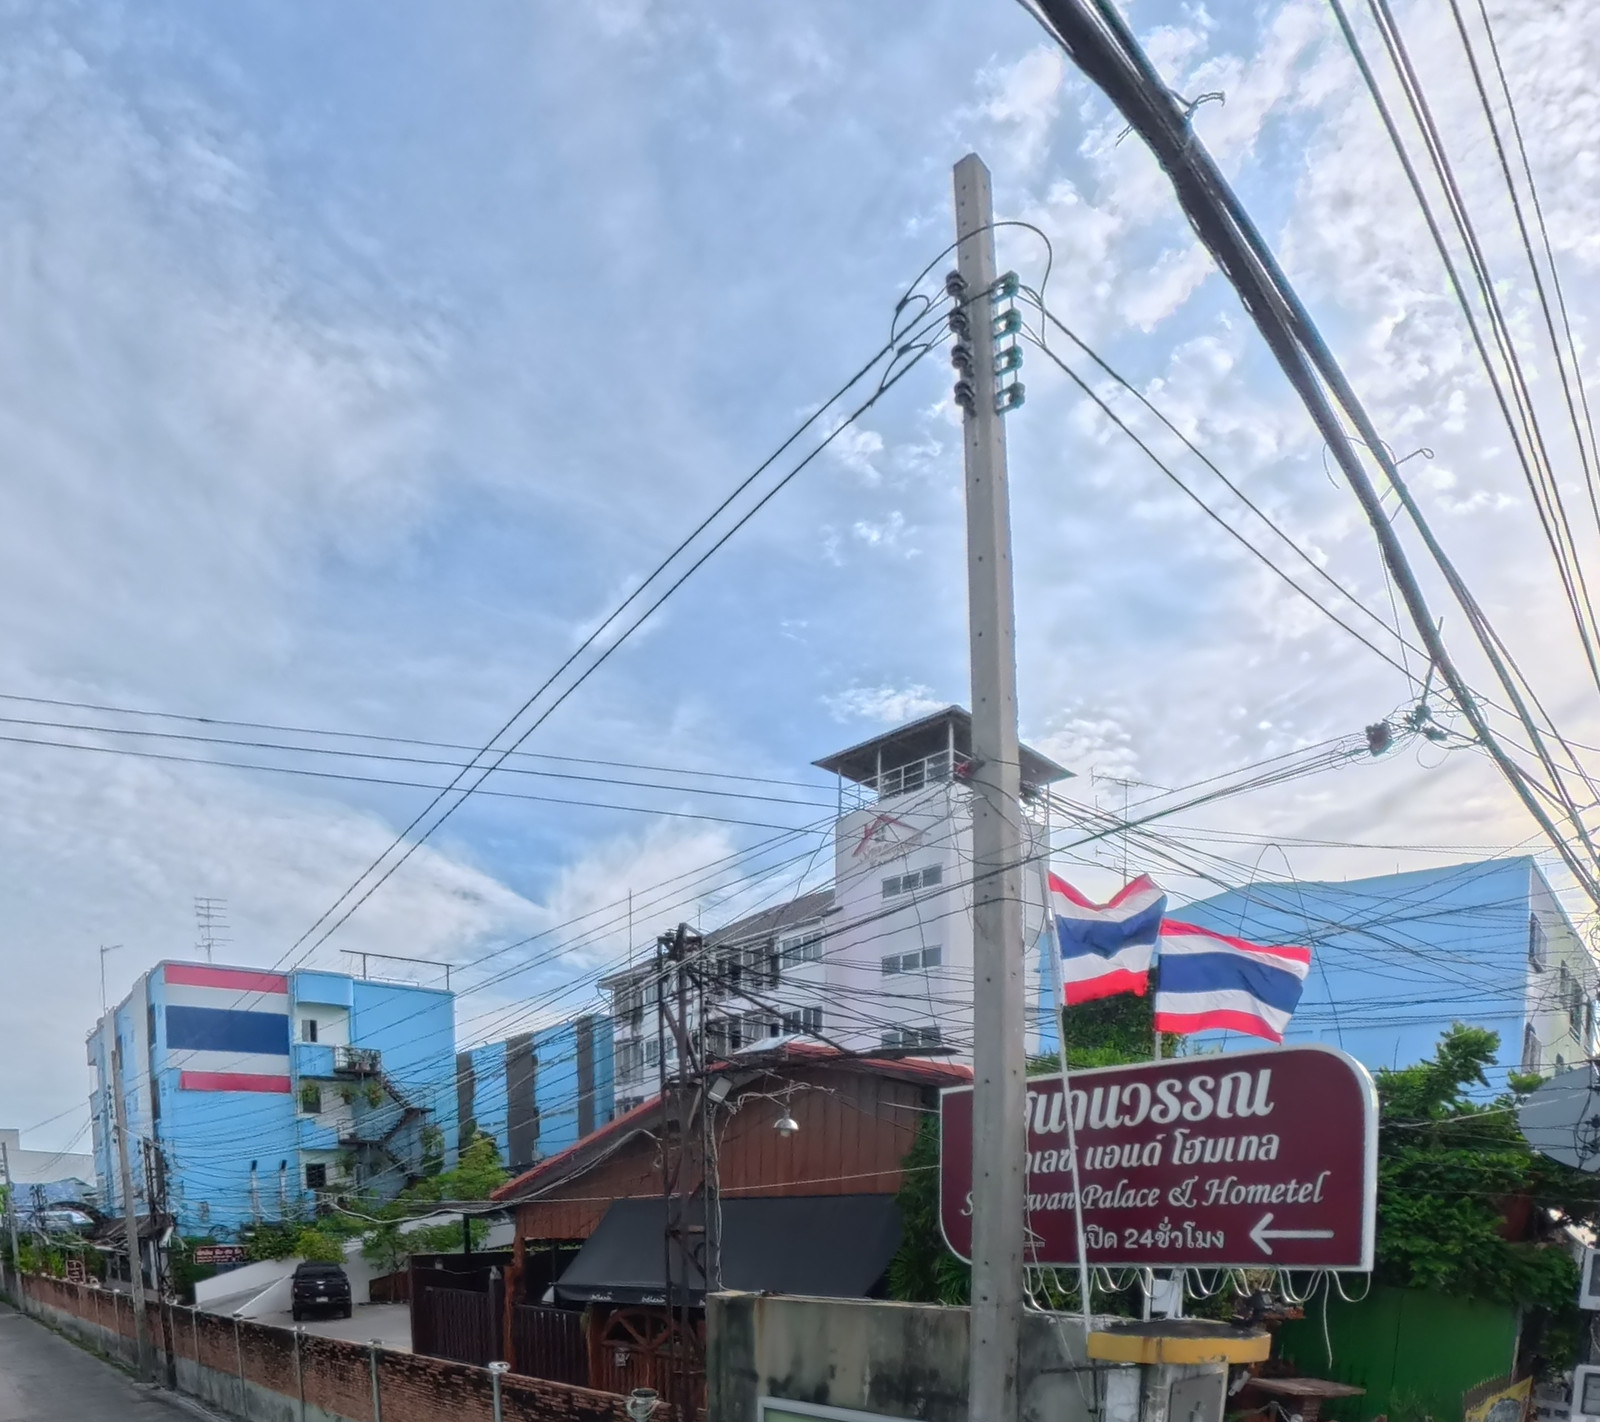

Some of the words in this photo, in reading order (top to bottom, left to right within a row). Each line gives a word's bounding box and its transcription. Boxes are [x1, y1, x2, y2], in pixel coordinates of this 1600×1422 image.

[1171, 1128, 1280, 1165] โฮมเทล
[1081, 1178, 1160, 1210] Palace
[1168, 1175, 1199, 1208] &
[1201, 1170, 1331, 1207] Hometel
[1124, 1216, 1225, 1249] 24ชั่วโมง
